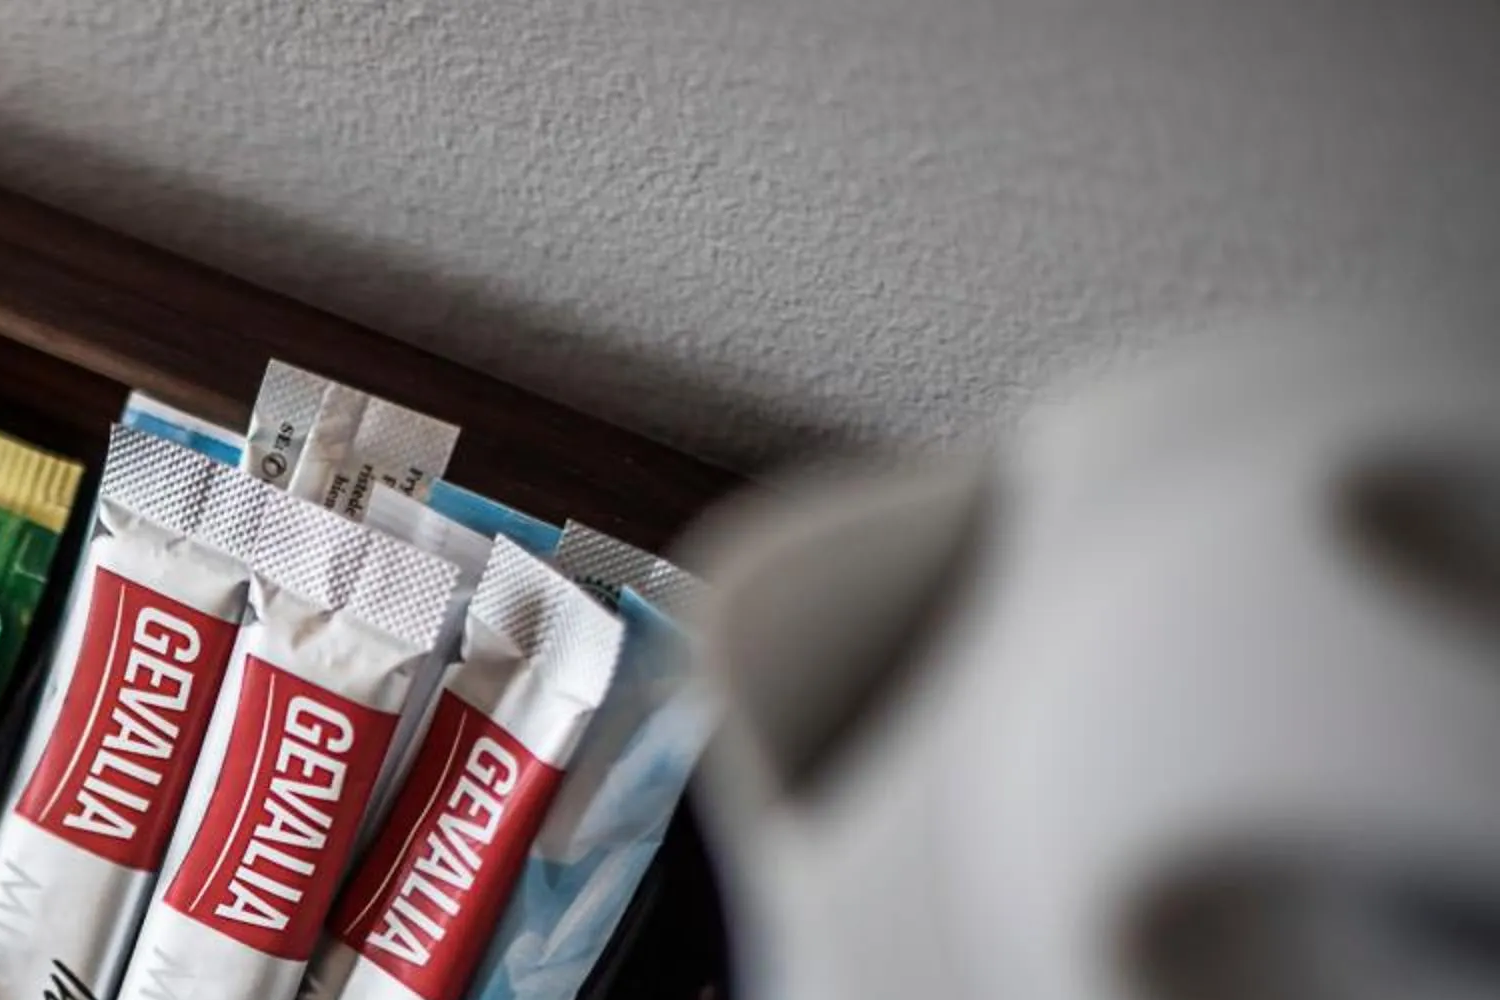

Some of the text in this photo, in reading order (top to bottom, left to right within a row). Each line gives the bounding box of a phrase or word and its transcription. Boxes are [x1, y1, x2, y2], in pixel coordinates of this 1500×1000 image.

[62, 605, 202, 841] GEVALIA
[215, 696, 354, 932] GEVALIA
[366, 736, 519, 968] GEVALIA
